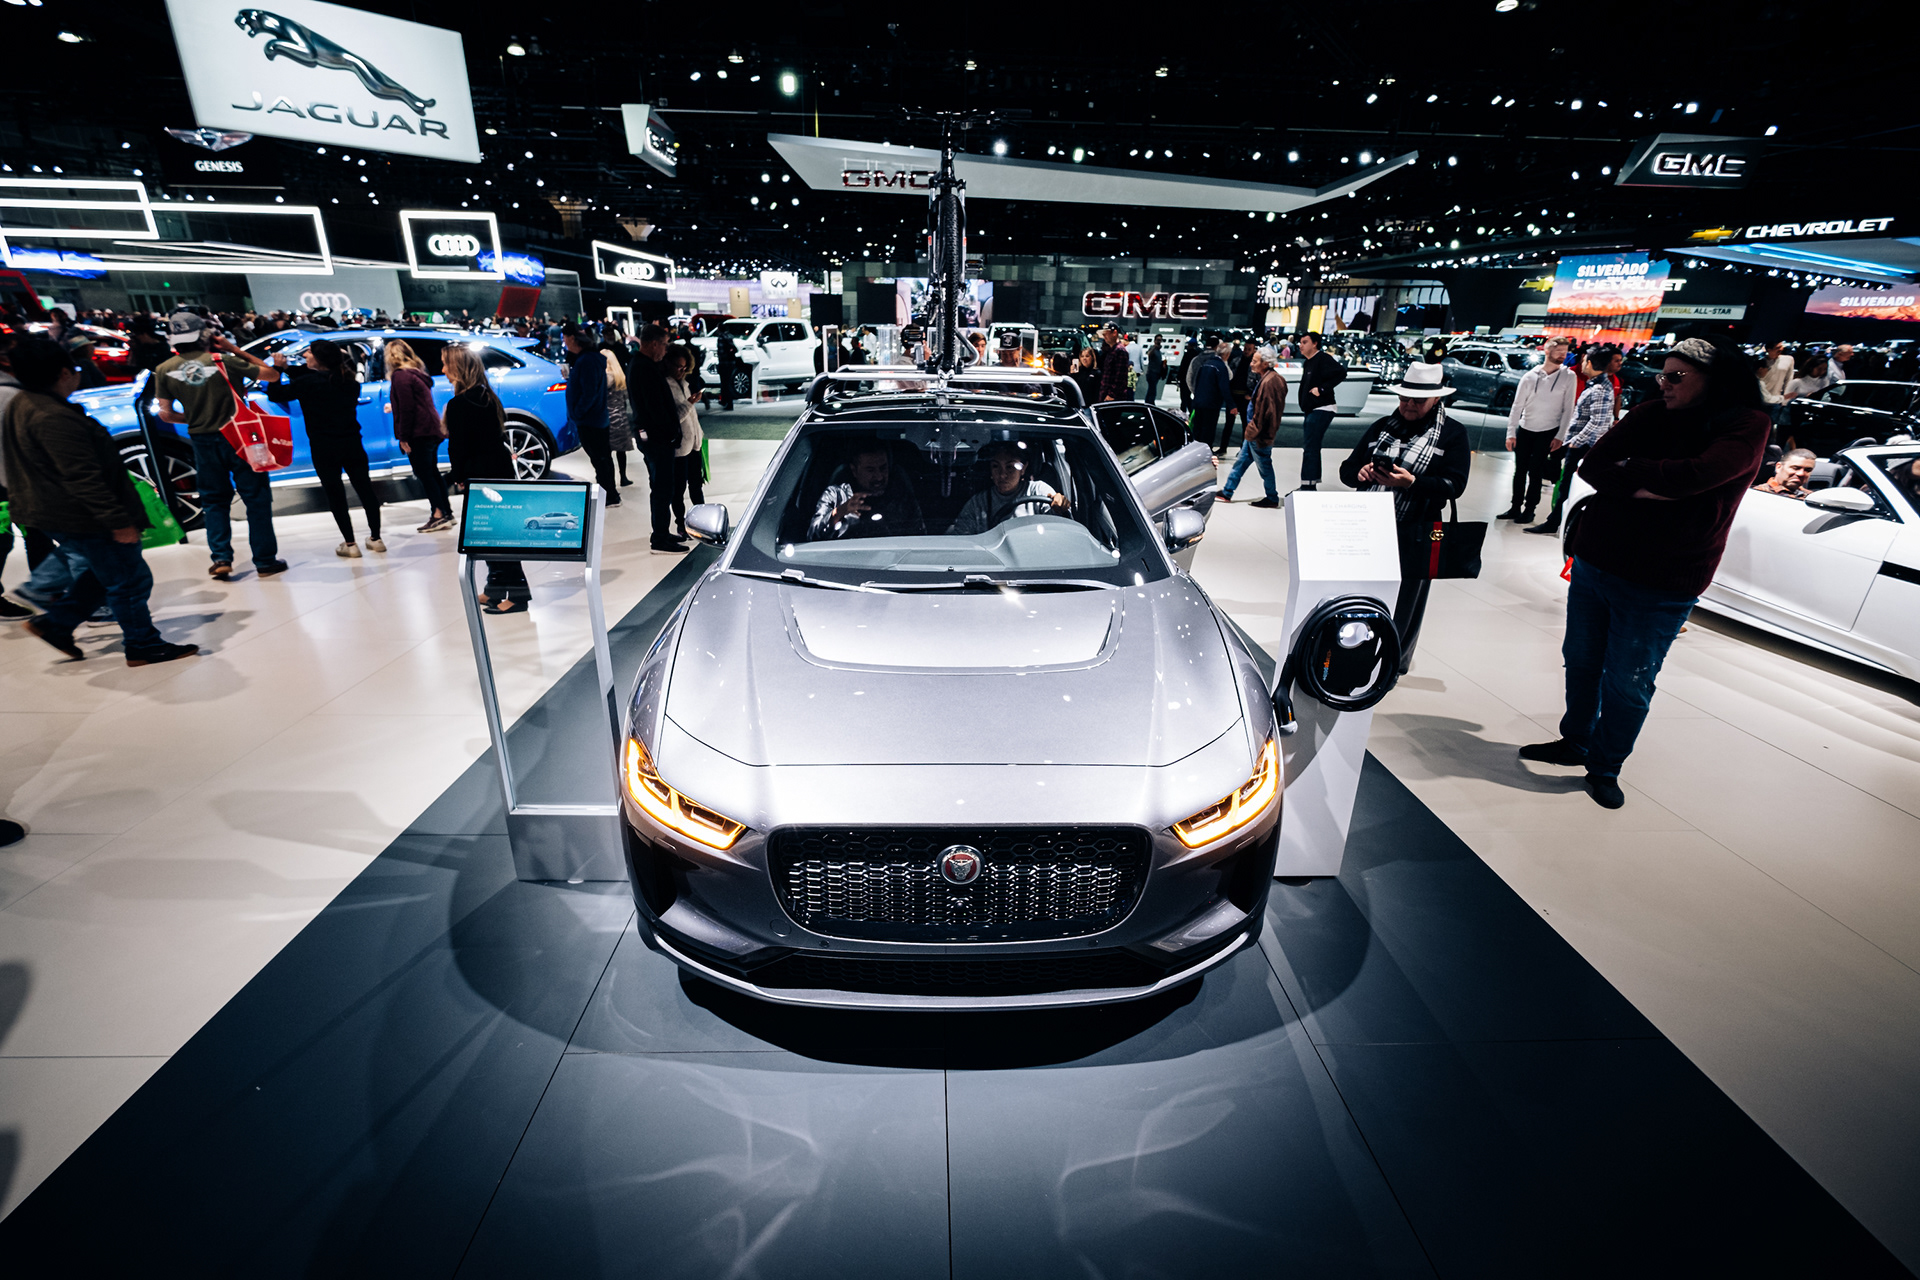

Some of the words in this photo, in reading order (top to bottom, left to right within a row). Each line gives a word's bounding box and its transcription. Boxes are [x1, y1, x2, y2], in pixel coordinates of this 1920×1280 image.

[231, 91, 451, 140] JAGUAR
[194, 160, 244, 172] GENESIS
[1651, 152, 1747, 177] GMC
[841, 169, 937, 188] GMC
[1744, 217, 1895, 239] CHEVROLET
[1577, 263, 1649, 277] SILVERADO
[1082, 291, 1210, 319] GMC
[1661, 307, 1692, 315] VIRTUAL
[1839, 296, 1915, 307] SILVERADO
